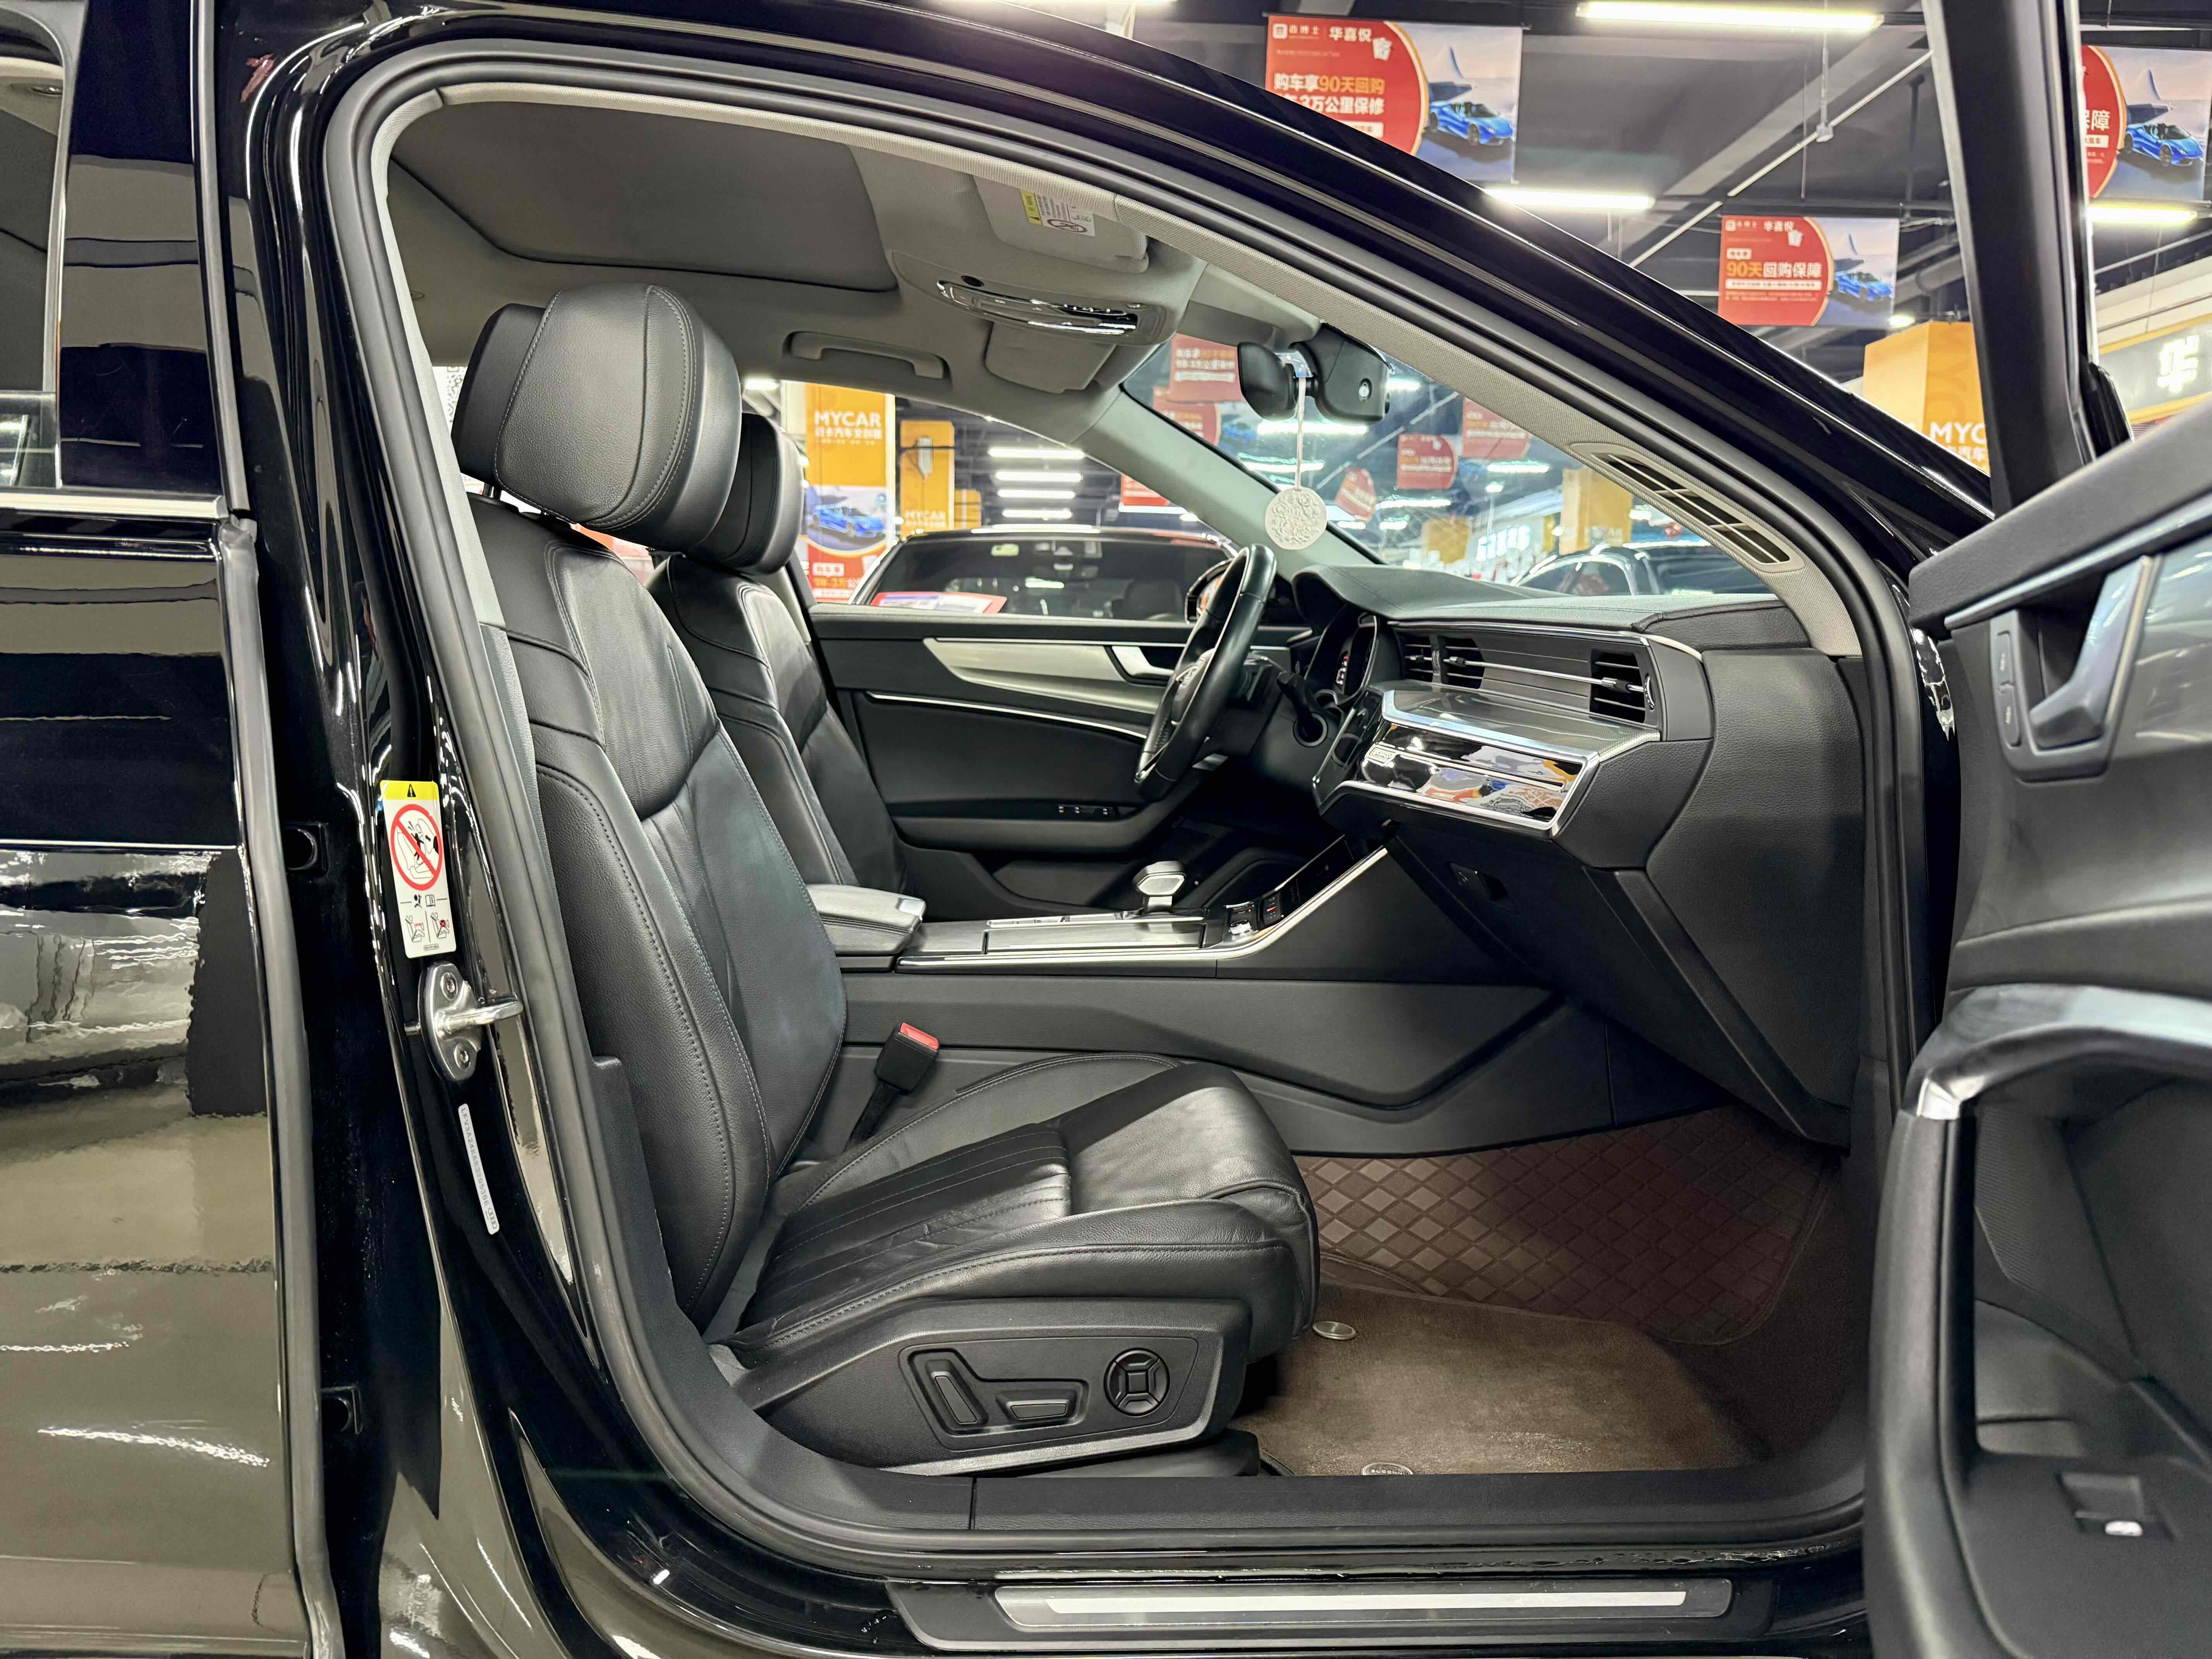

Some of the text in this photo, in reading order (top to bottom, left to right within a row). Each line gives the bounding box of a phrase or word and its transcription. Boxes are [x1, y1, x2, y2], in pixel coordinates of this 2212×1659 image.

[1727, 261, 1822, 278] 90天回购保障
[814, 410, 881, 428] MYCAR
